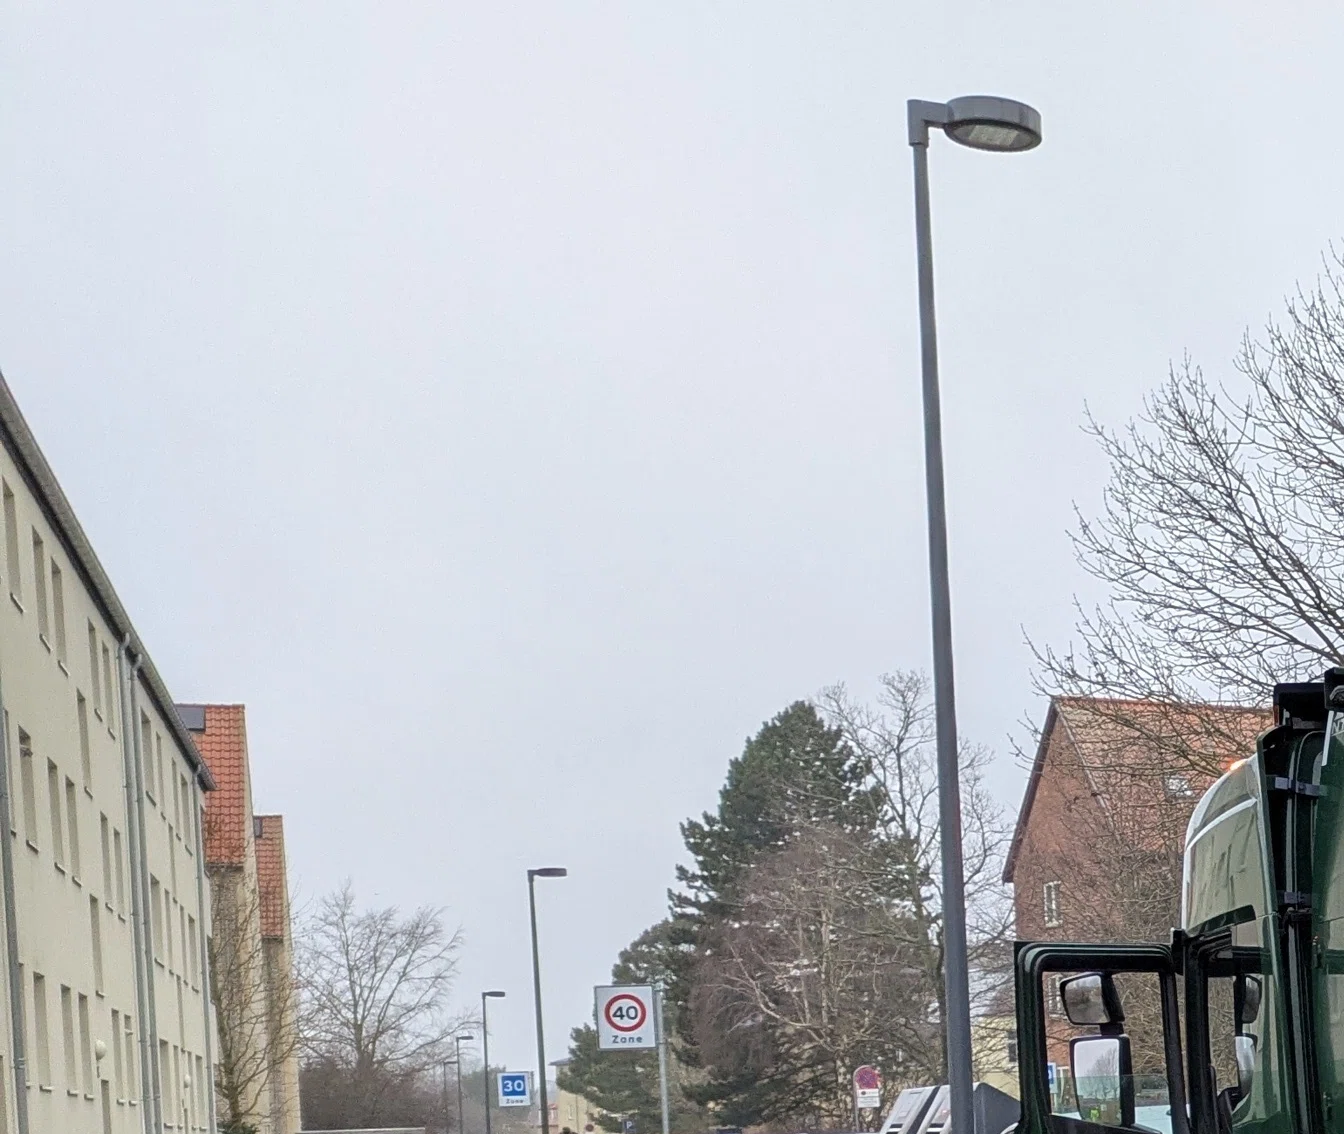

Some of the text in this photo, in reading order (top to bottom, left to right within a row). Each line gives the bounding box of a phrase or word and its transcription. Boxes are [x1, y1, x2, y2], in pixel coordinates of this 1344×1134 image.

[612, 1005, 639, 1020] 40
[612, 1035, 643, 1044] Zone
[503, 1080, 524, 1092] 30
[626, 1121, 633, 1129] P
